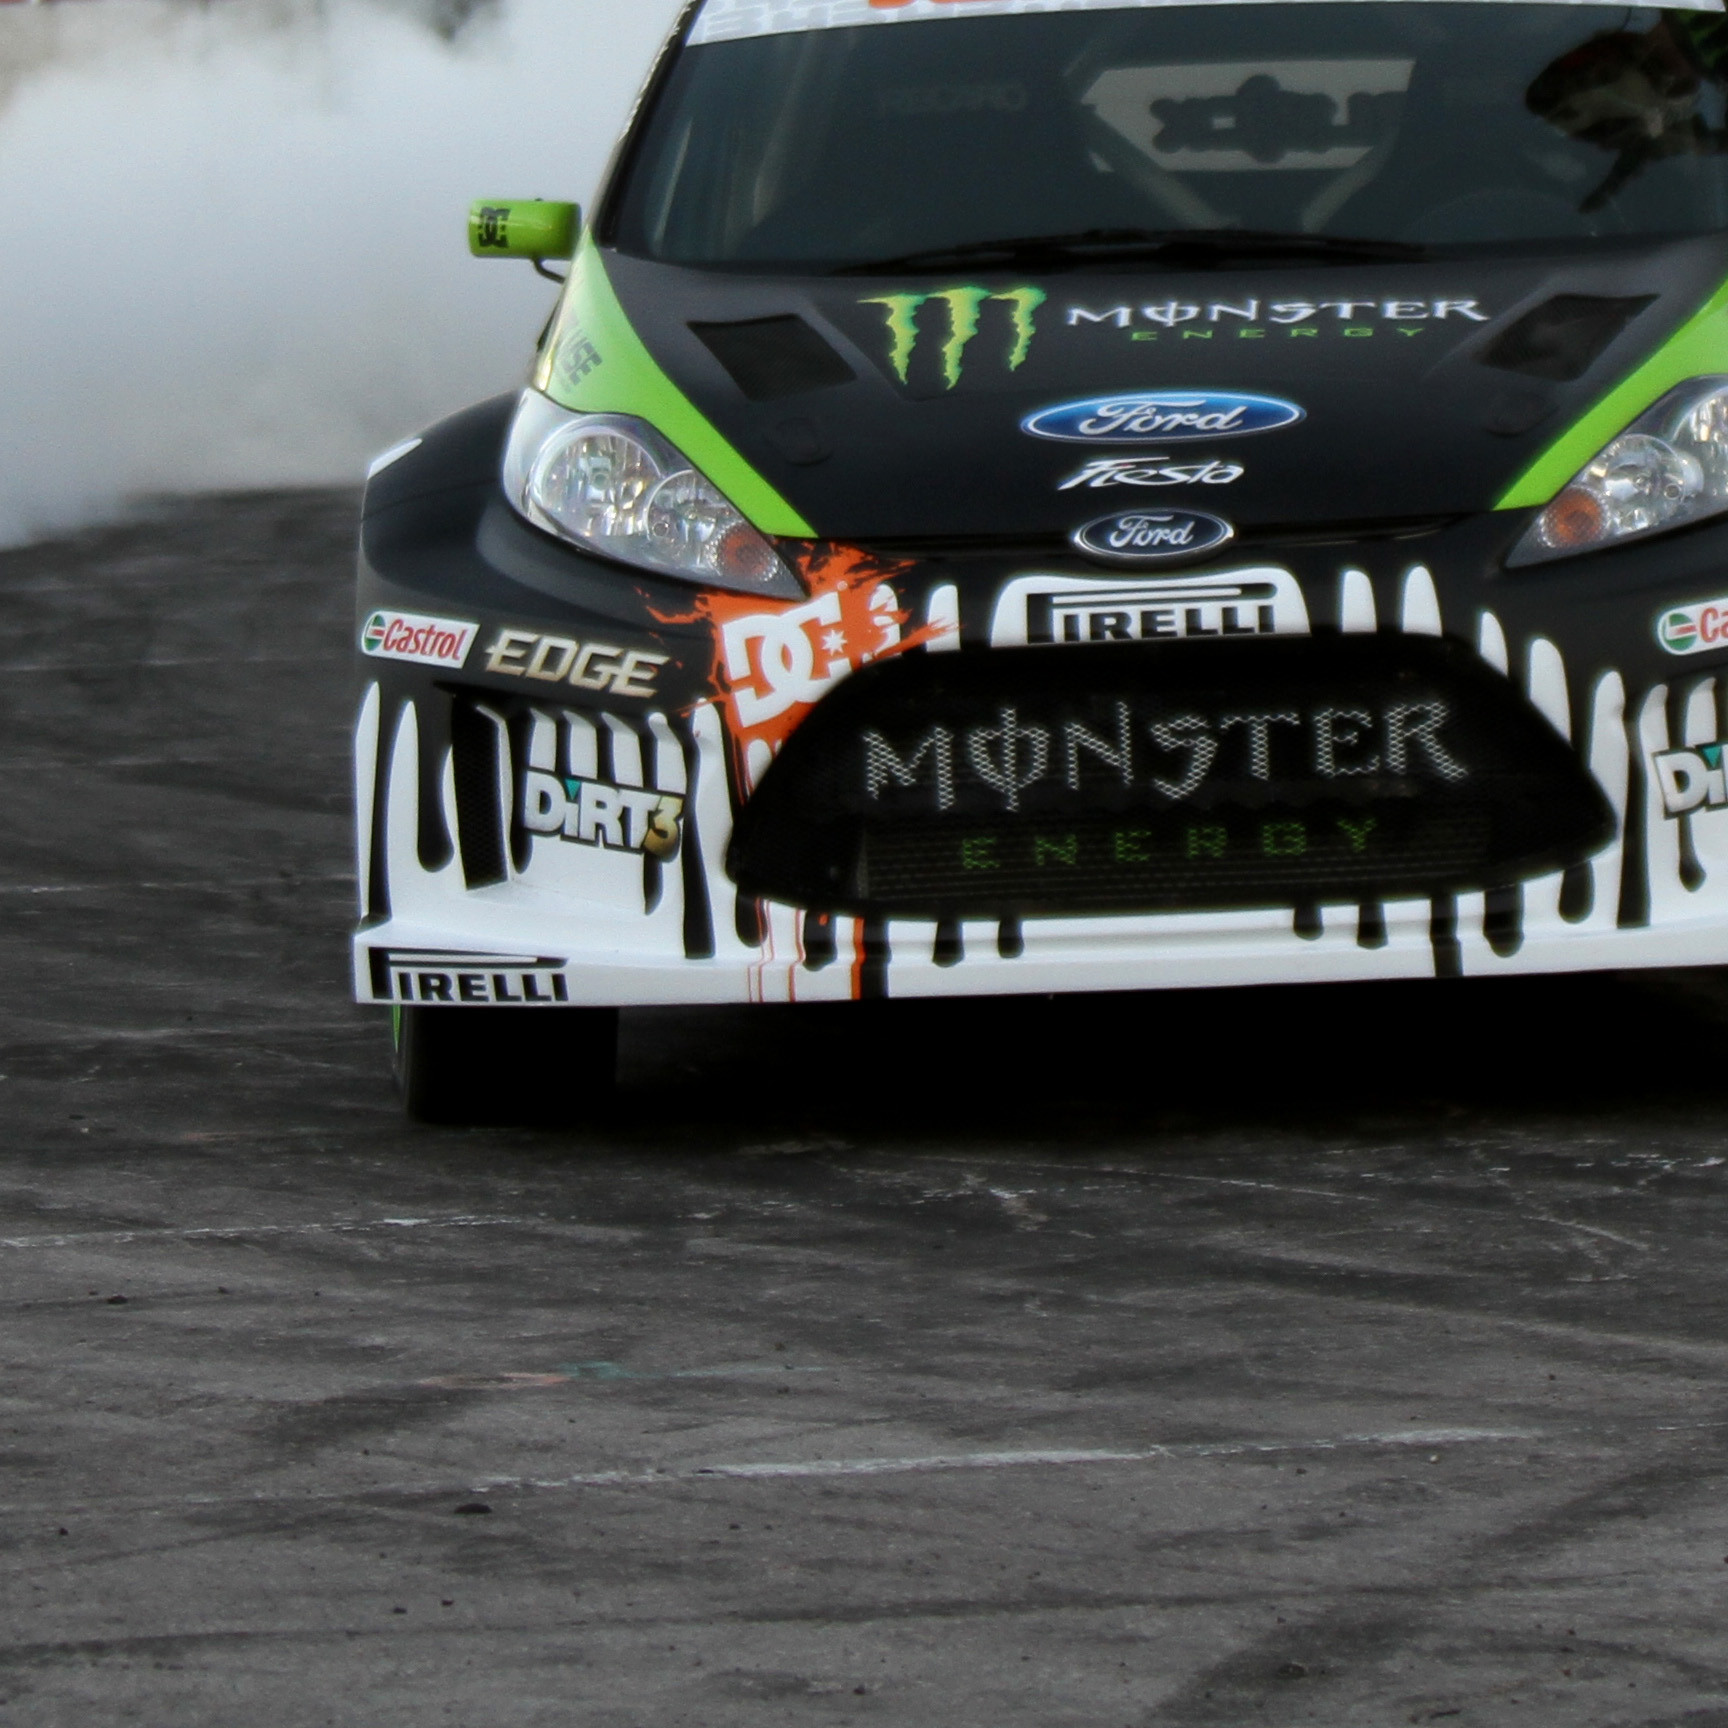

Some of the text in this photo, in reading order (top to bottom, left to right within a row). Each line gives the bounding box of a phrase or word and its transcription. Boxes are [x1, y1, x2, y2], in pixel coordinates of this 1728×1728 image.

[1067, 298, 1490, 328] MONSTER
[1130, 327, 1425, 341] ENERGY
[1077, 399, 1249, 436] Ford
[1057, 456, 1245, 490] Fiesta
[1108, 514, 1194, 548] Ford
[1025, 582, 1279, 645] PIRELLI
[383, 618, 670, 699] Castrol EDGE
[861, 700, 1469, 813] MONSTER
[960, 817, 1376, 870] ENERGY
[367, 945, 569, 1002] PIRELLI
